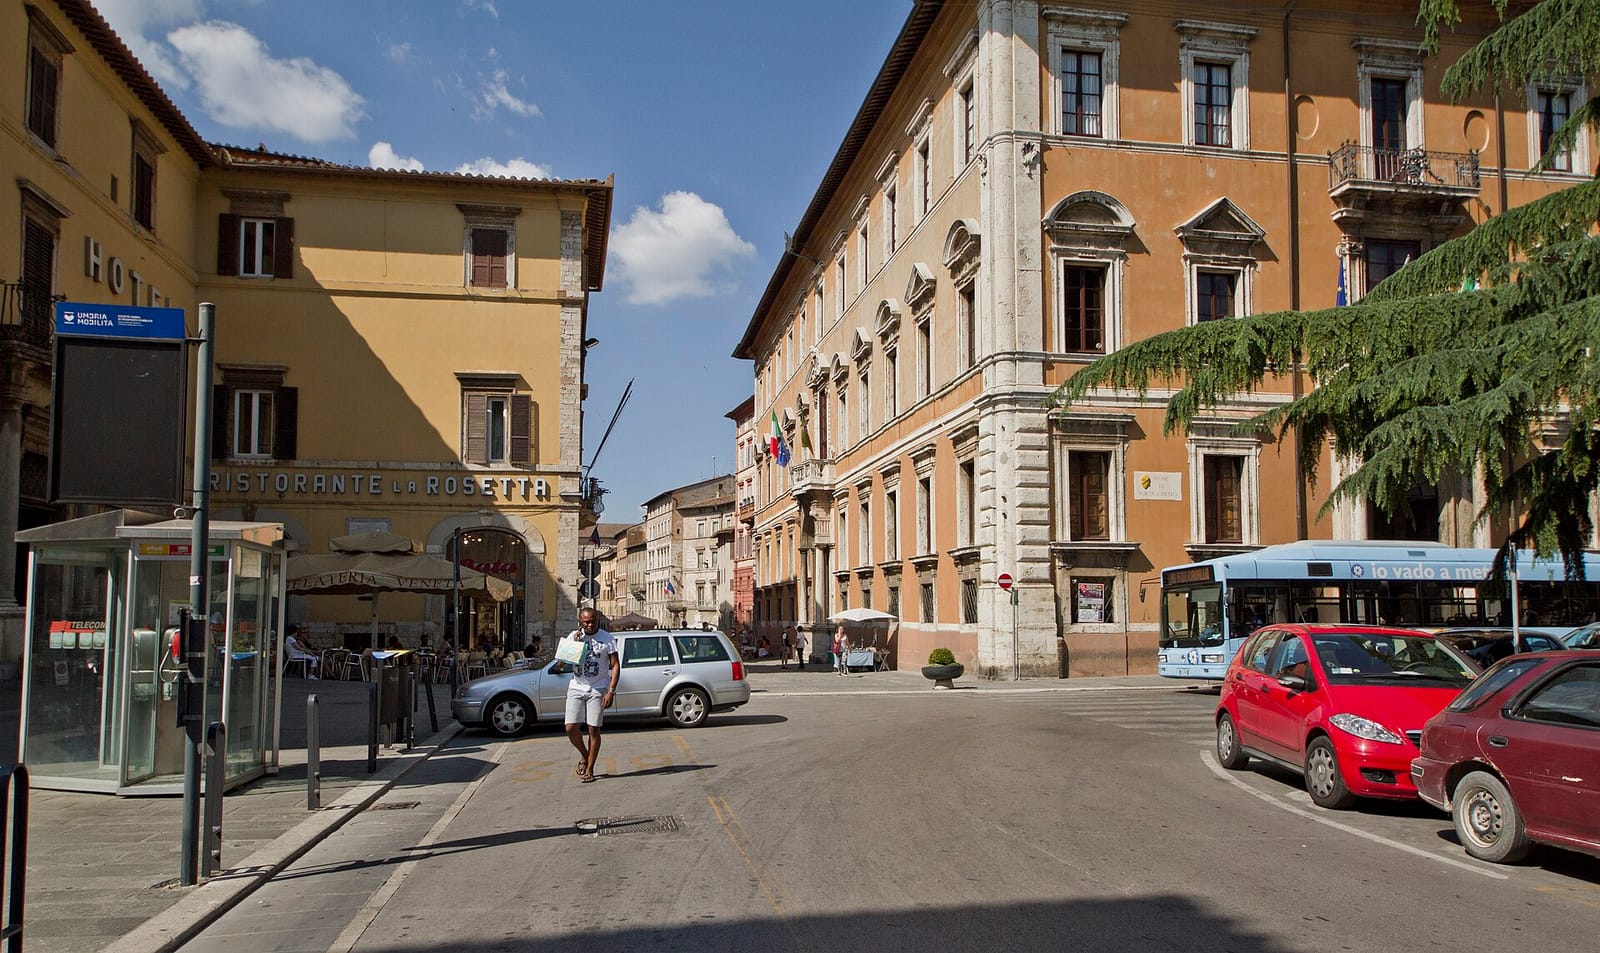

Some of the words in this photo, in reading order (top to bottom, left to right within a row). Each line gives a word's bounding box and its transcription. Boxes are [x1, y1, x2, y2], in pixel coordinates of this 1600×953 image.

[210, 472, 383, 494] RISTORANTE
[427, 476, 547, 497] ROSETTA
[1371, 562, 1388, 579] io
[1393, 562, 1435, 579] vado
[1440, 567, 1451, 579] a
[287, 571, 376, 589] ELATERIA
